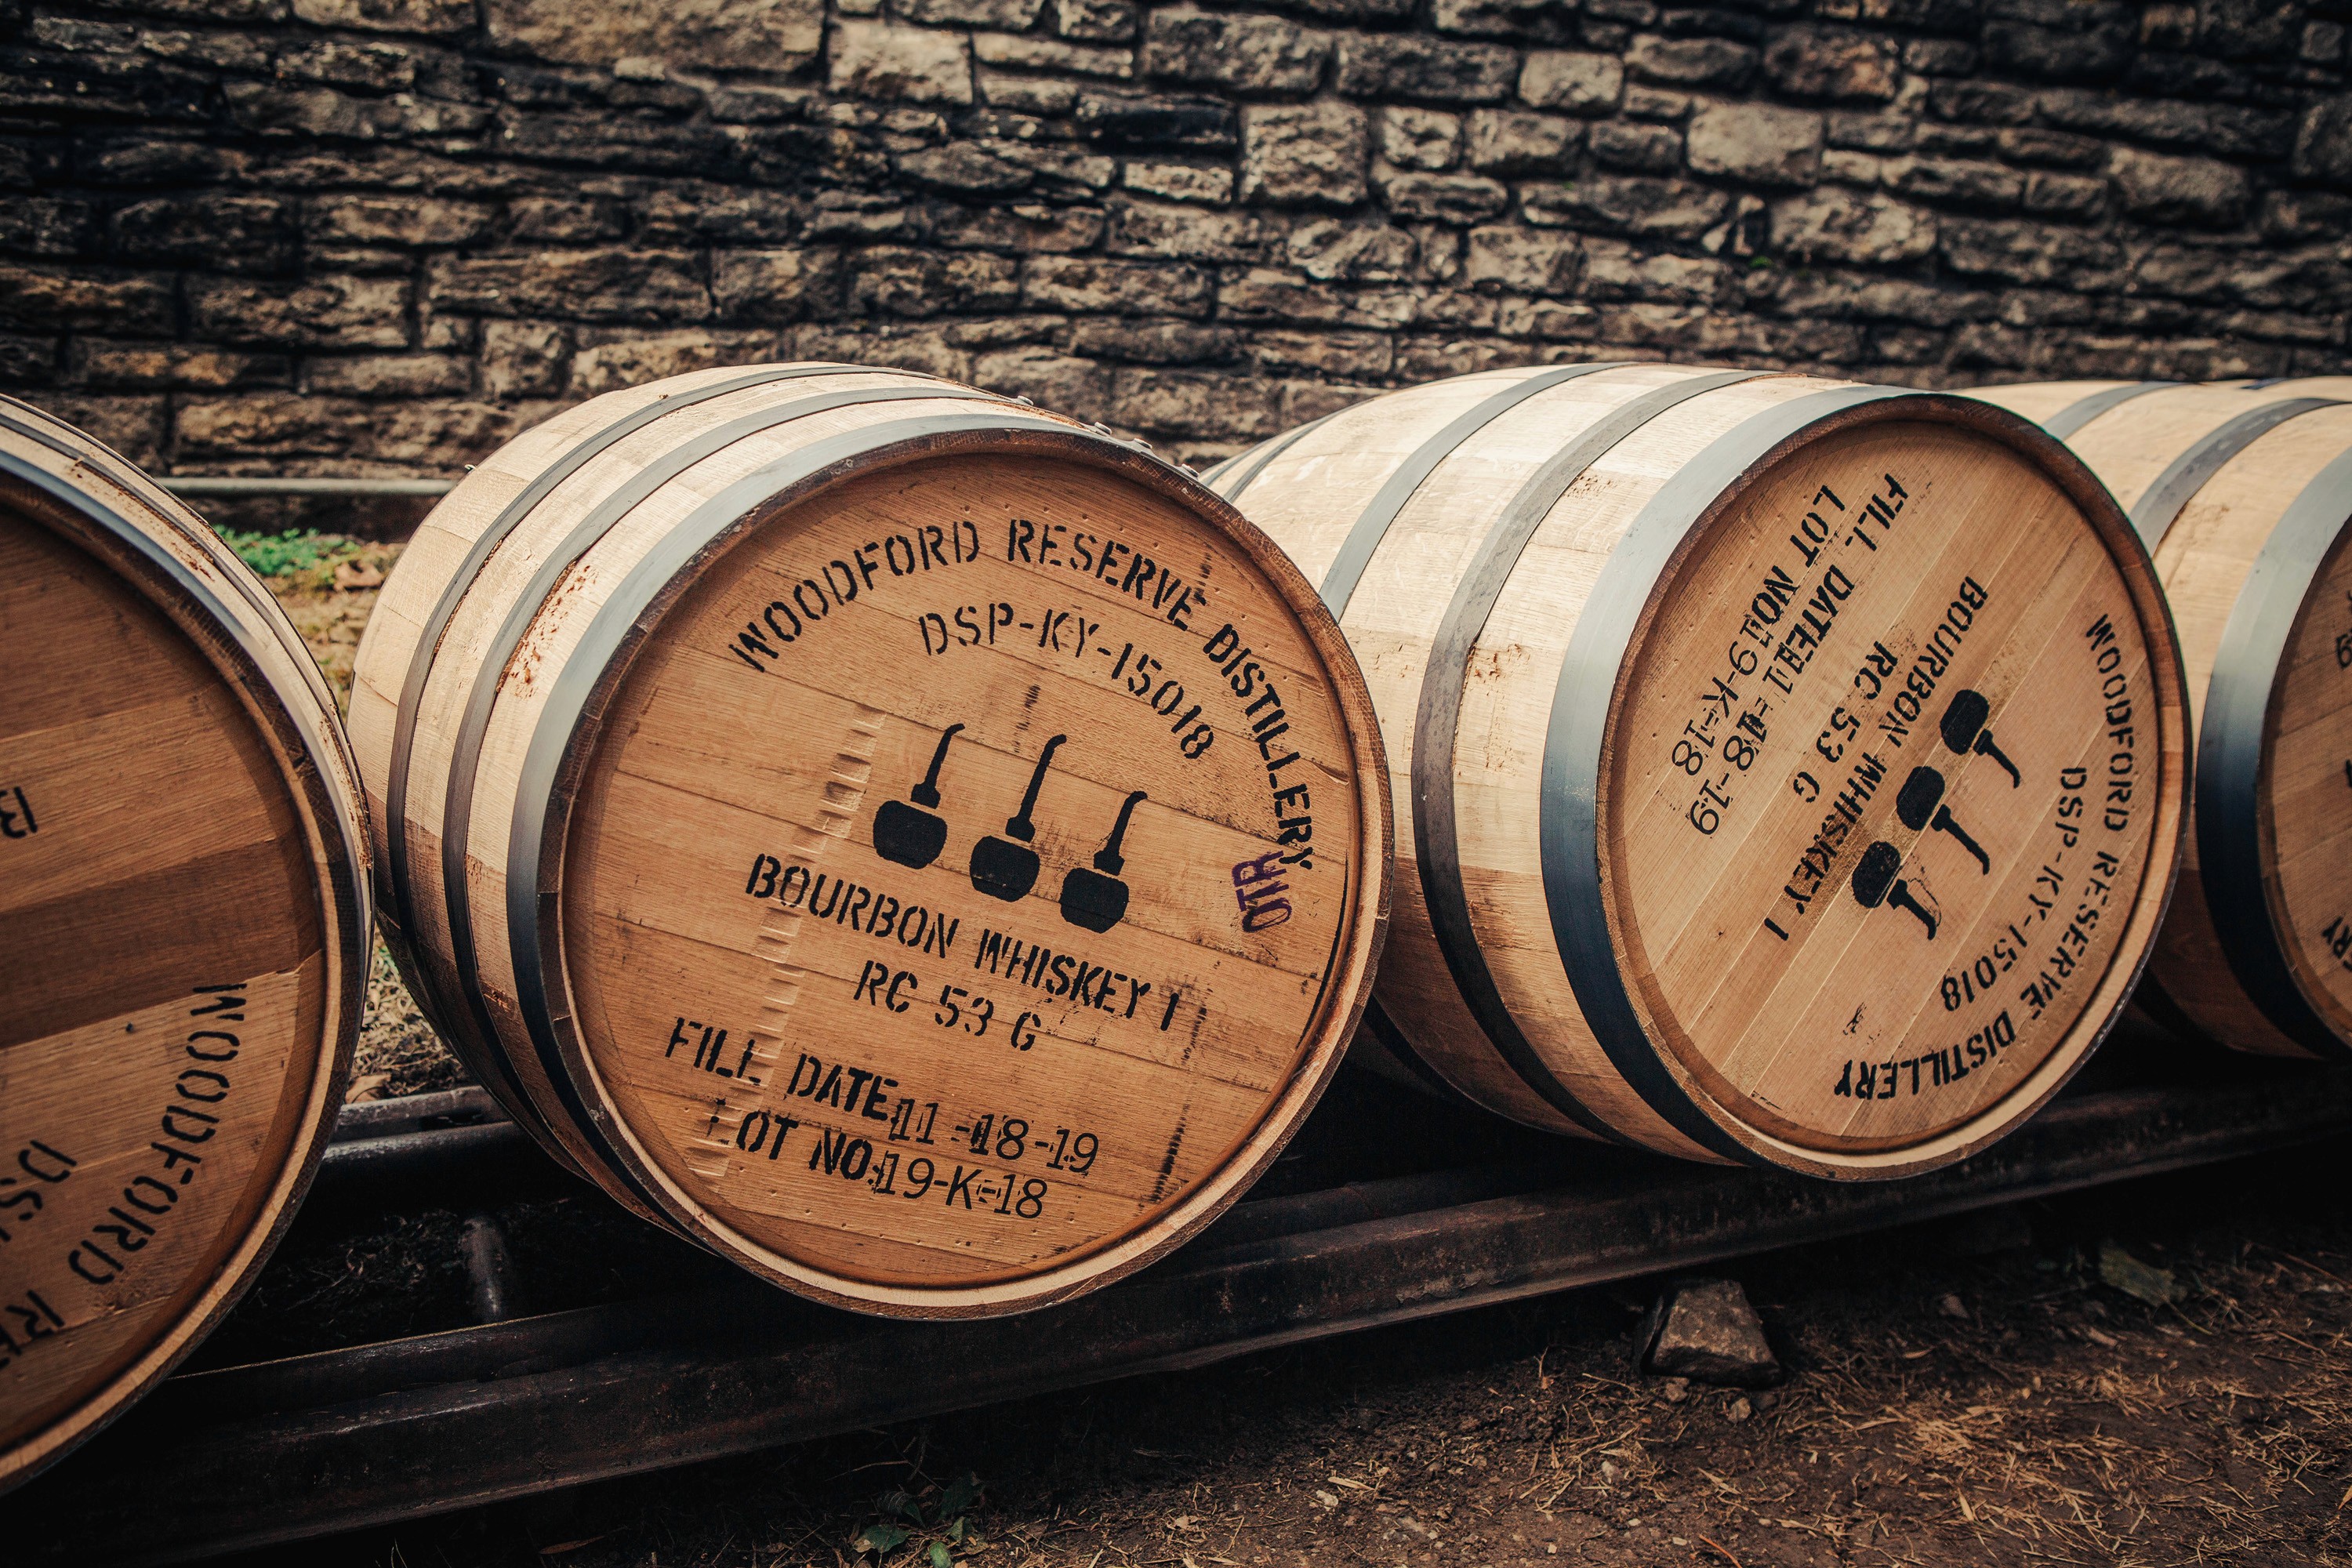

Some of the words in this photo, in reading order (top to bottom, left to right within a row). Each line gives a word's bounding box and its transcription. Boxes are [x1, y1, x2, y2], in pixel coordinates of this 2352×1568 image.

[1790, 485, 1845, 568] LOT
[1846, 474, 1908, 551] FILL
[728, 520, 981, 673] WOODFORD
[1007, 519, 1208, 632] RESERVE
[1203, 623, 1314, 870] DISTILLERY
[917, 603, 1215, 760] DSP-KY-15018
[1854, 641, 1898, 699] RC
[1879, 576, 1988, 748] BOURBON
[2085, 613, 2133, 831] WOODFORD
[1793, 771, 1820, 803] G
[1817, 706, 1860, 763] 53
[1232, 849, 1292, 933] OTR
[1784, 752, 1887, 915] WHISKEY
[1940, 768, 2087, 1011] DSP-KY-15018
[745, 853, 959, 958] BOURBON
[975, 929, 1151, 1018] WHISKEY
[2020, 851, 2119, 1020] RESERVE
[665, 1017, 761, 1086] FILL
[854, 960, 918, 1013] RC
[935, 985, 994, 1036] 53
[1010, 1011, 1041, 1051] G
[1834, 1008, 2016, 1100] DISTILLERY
[69, 983, 247, 1285] WOODFORD
